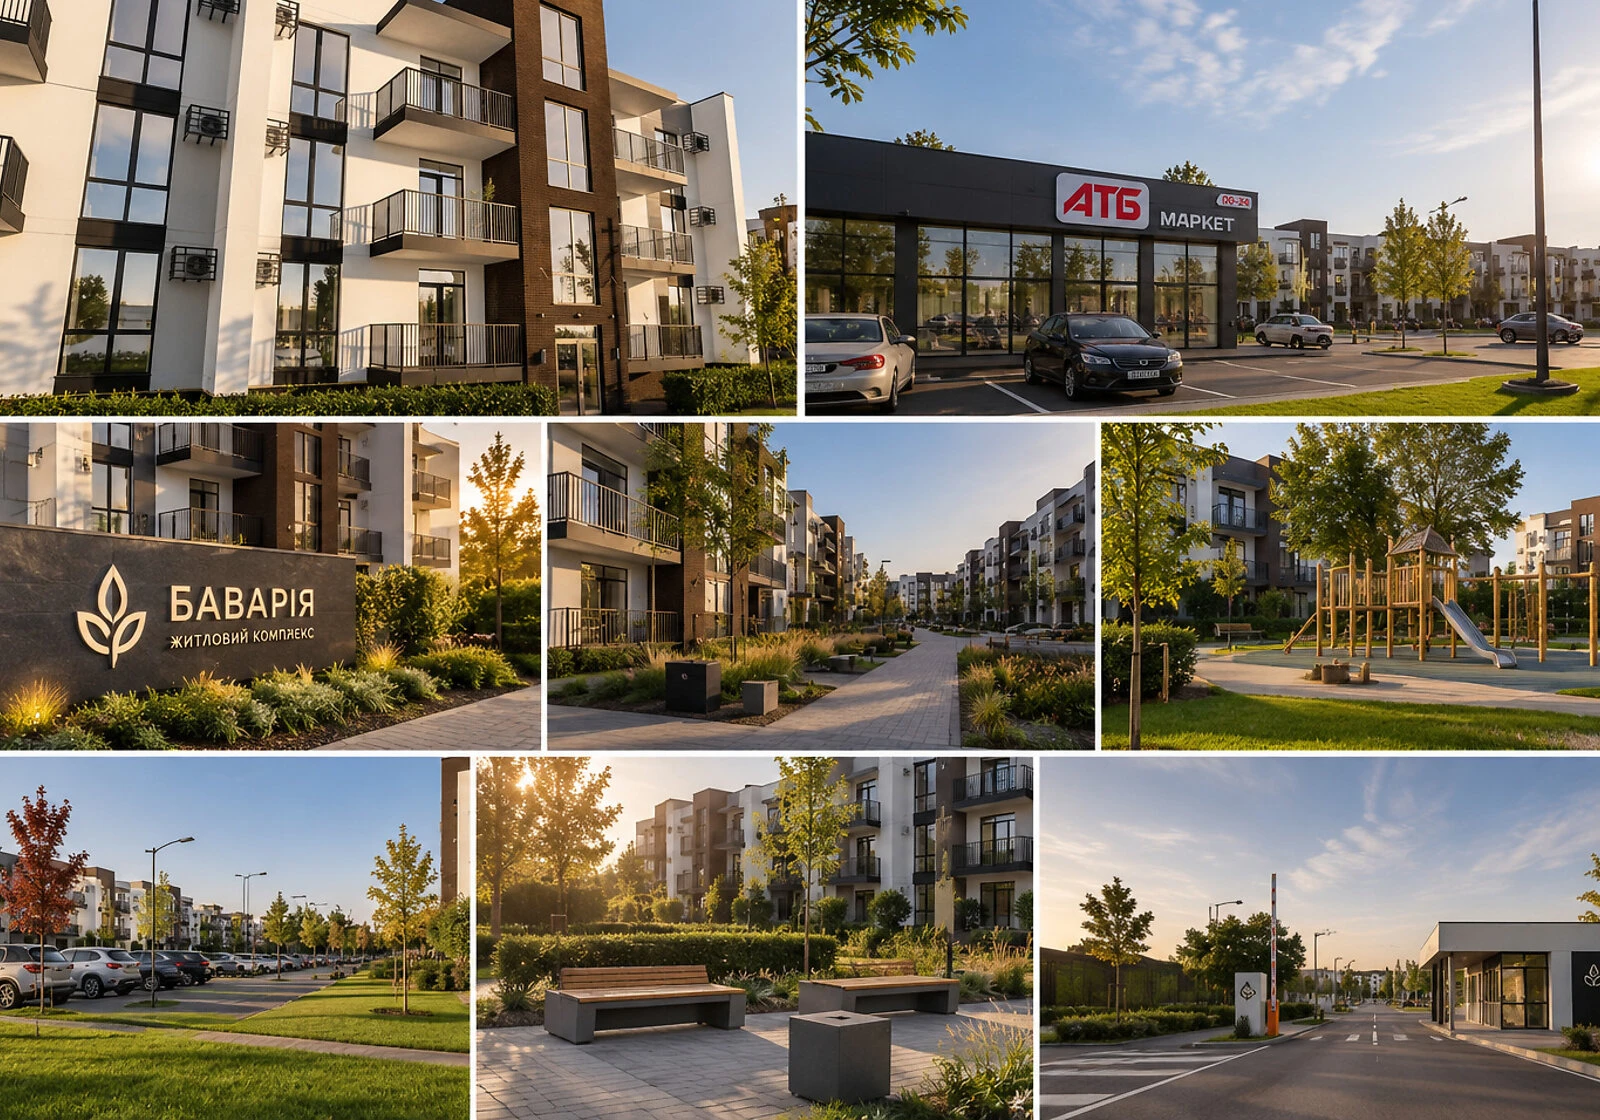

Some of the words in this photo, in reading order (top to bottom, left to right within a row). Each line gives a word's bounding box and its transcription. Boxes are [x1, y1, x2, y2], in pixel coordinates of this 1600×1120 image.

[1063, 182, 1142, 221] АТБ
[1160, 211, 1235, 232] МАРКЕТ
[170, 585, 315, 622] БАВАРІЯ
[170, 628, 249, 649] ЖИТЛОВИЙ
